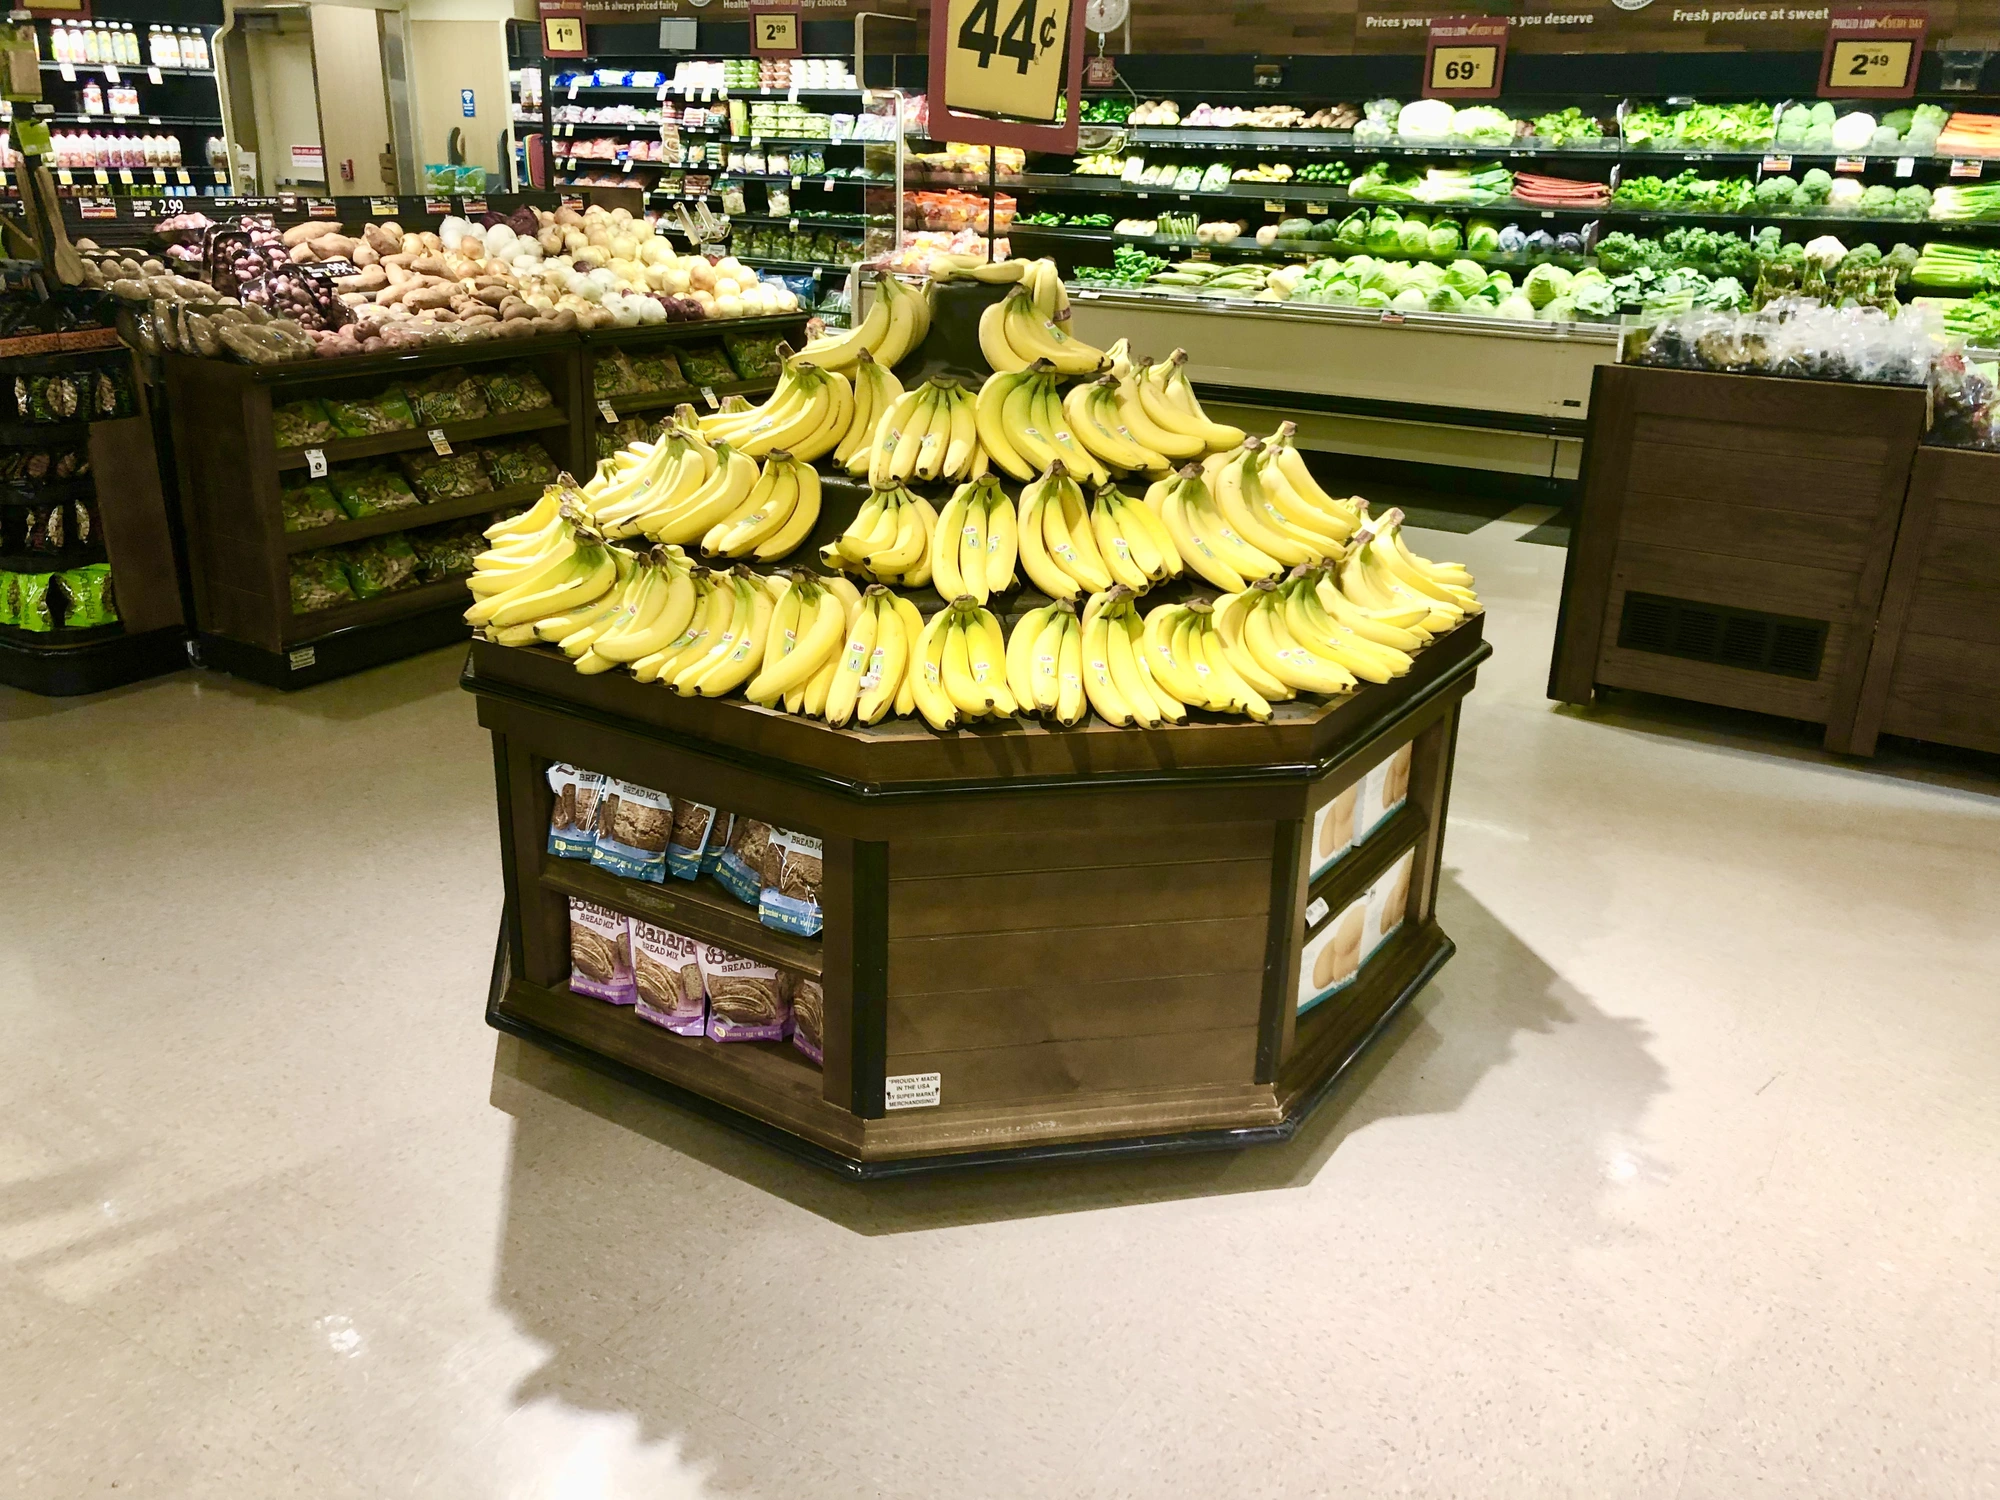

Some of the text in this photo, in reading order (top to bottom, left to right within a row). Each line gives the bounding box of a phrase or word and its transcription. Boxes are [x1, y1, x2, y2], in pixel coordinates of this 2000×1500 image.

[612, 1, 635, 12] always
[637, 2, 658, 11] priced
[659, 1, 678, 11] fairly
[1366, 17, 1399, 28] Prices
[1402, 19, 1423, 29] you
[1519, 16, 1541, 27] you
[1544, 13, 1593, 25] deserve
[1673, 8, 1829, 23] Fresh produce at sweet
[159, 199, 183, 214] 2.99
[623, 785, 660, 801] BREAD MIX
[790, 835, 814, 849] BREAD
[580, 913, 614, 930] BREAD MIX
[635, 920, 696, 957] Banana
[642, 942, 680, 961] BREAD MIX
[721, 962, 751, 972] BREAD
